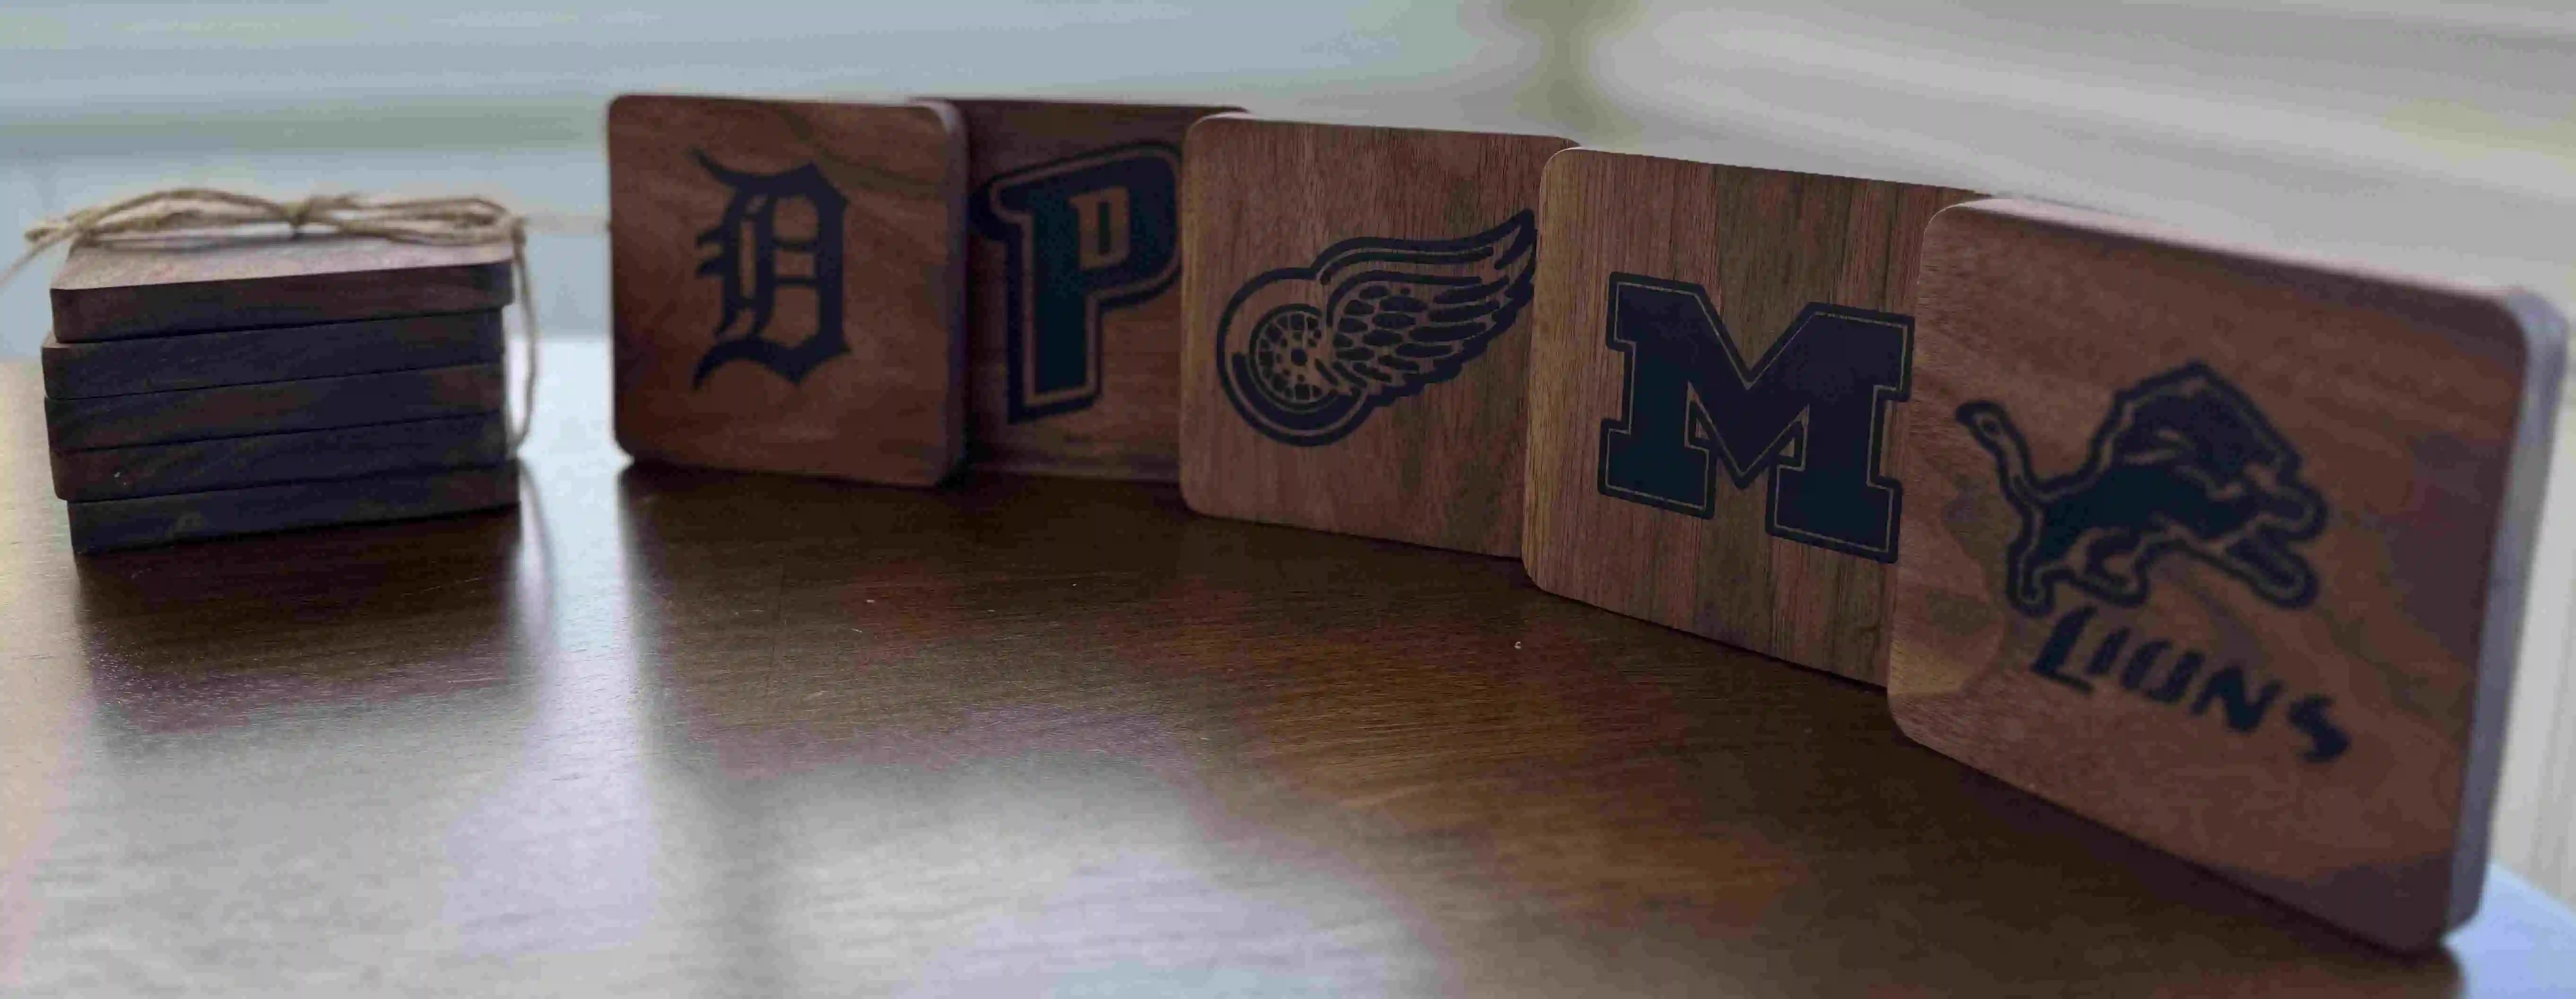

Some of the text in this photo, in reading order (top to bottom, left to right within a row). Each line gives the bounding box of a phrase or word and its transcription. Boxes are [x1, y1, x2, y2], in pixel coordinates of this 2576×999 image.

[689, 147, 851, 394] D
[967, 141, 1182, 425] P
[1597, 272, 1915, 564] M
[2030, 605, 2352, 763] LIONS
